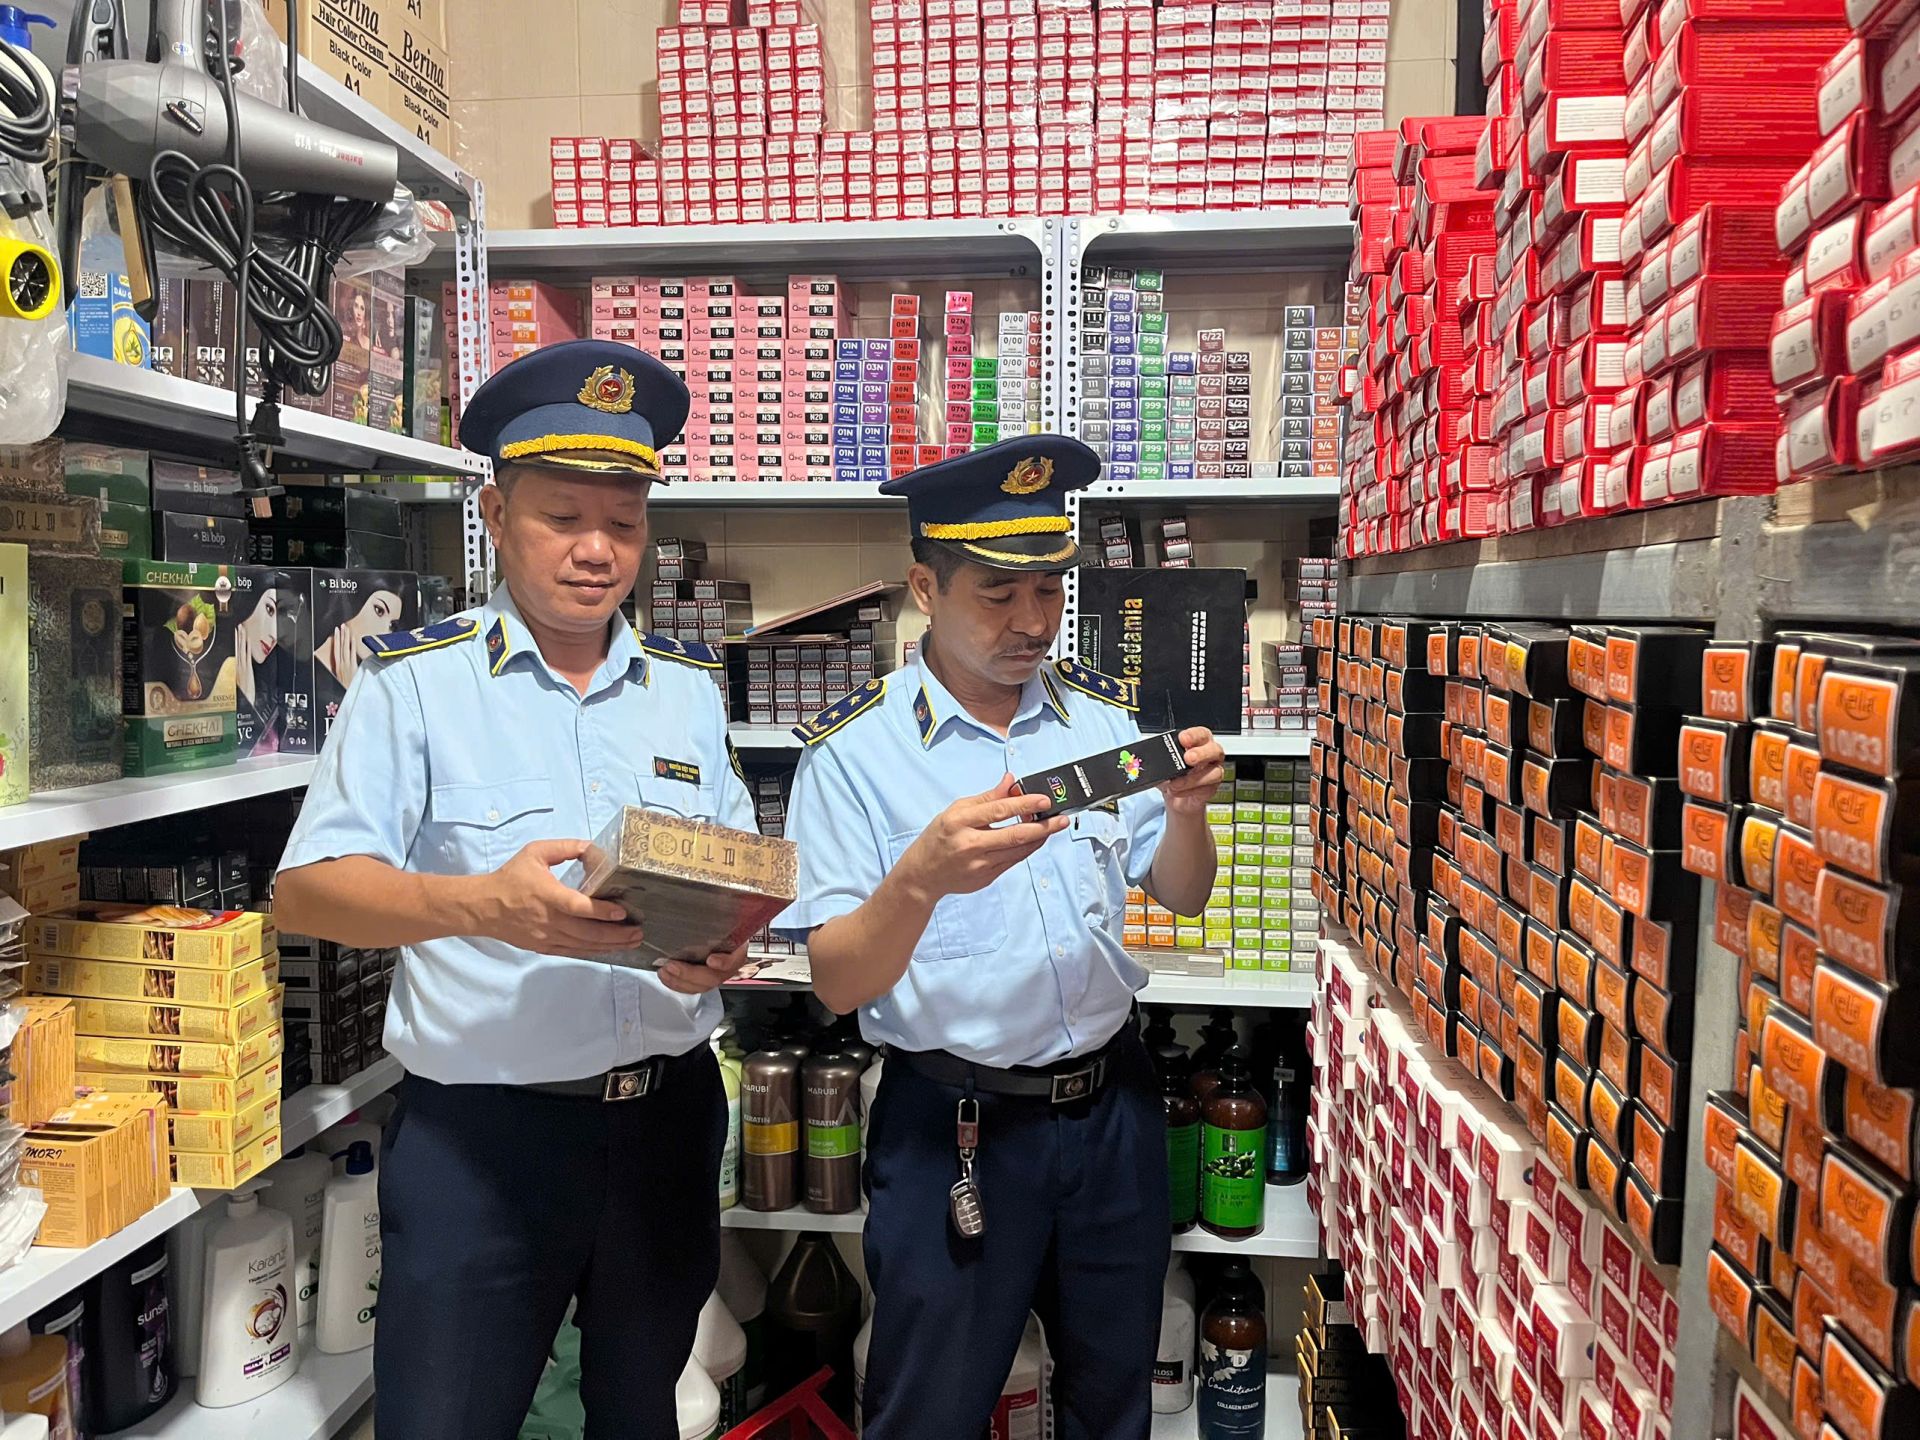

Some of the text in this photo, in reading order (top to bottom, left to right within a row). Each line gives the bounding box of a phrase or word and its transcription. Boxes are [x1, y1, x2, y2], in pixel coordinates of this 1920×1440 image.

[319, 4, 384, 61] Hair Color Cream
[330, 39, 372, 78] Black Color
[402, 30, 444, 89] Berina
[344, 73, 360, 96] A1
[395, 63, 447, 113] Hair Color Cream
[404, 95, 439, 129] Black Color
[417, 124, 430, 145] A1
[1140, 279, 1157, 287] 666
[1005, 315, 1023, 323] 0/00
[1292, 309, 1304, 318] 7/1
[1004, 337, 1022, 345] 0/00
[1202, 332, 1221, 341] 6/22
[1293, 332, 1305, 340] 7/1
[1321, 332, 1336, 340] 9/4
[870, 342, 887, 350] 03N
[1320, 354, 1334, 362] 9/4
[1201, 377, 1221, 386] 6/22
[1228, 377, 1248, 385] 5/22
[1290, 376, 1303, 385] 7/1
[1318, 420, 1333, 428] 9/4
[1226, 443, 1246, 451] 5/22
[1200, 464, 1220, 473] 6/22
[1289, 464, 1302, 473] 7/1
[193, 482, 203, 493] Bi
[201, 531, 211, 543] Bi
[146, 571, 193, 584] CHEKHAI
[329, 578, 340, 588] Bi
[1190, 612, 1199, 690] PROFESSIONAL
[1198, 611, 1207, 690] COLOUR CREAM
[1709, 688, 1738, 713] 7/33
[1827, 725, 1884, 765] 10/33
[1686, 767, 1715, 793] 7/33
[1819, 825, 1875, 872] 10/33
[1617, 881, 1640, 908] 6/33
[808, 1118, 838, 1126] KERATIN
[25, 1147, 63, 1159] MORI
[1232, 1355, 1248, 1367] D
